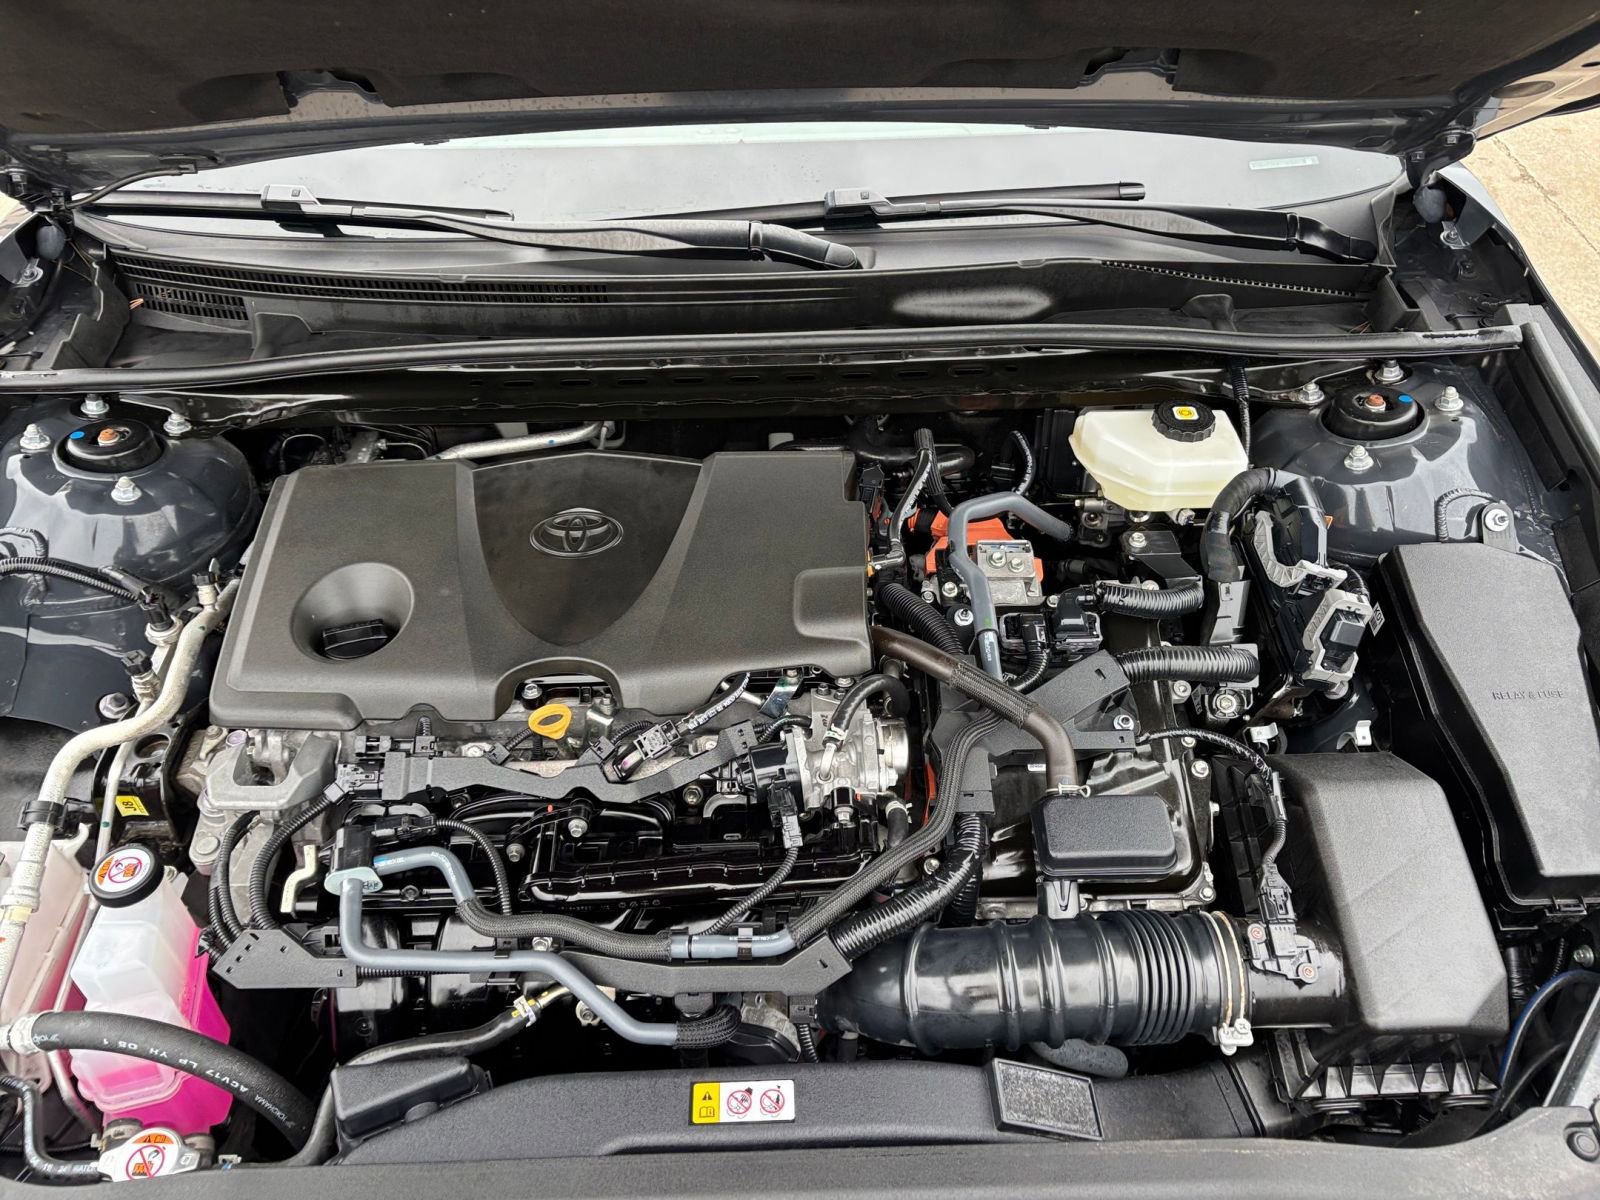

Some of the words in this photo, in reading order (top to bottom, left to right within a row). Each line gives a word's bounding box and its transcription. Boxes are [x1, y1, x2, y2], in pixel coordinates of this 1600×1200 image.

[1492, 690, 1525, 700] RELAY
[1537, 689, 1565, 699] FUSE
[122, 801, 137, 811] J8
[149, 1047, 168, 1058] YH
[178, 1058, 198, 1069] LP
[205, 1069, 249, 1093] ACV17
[254, 1094, 296, 1129] YOKOHAMA
